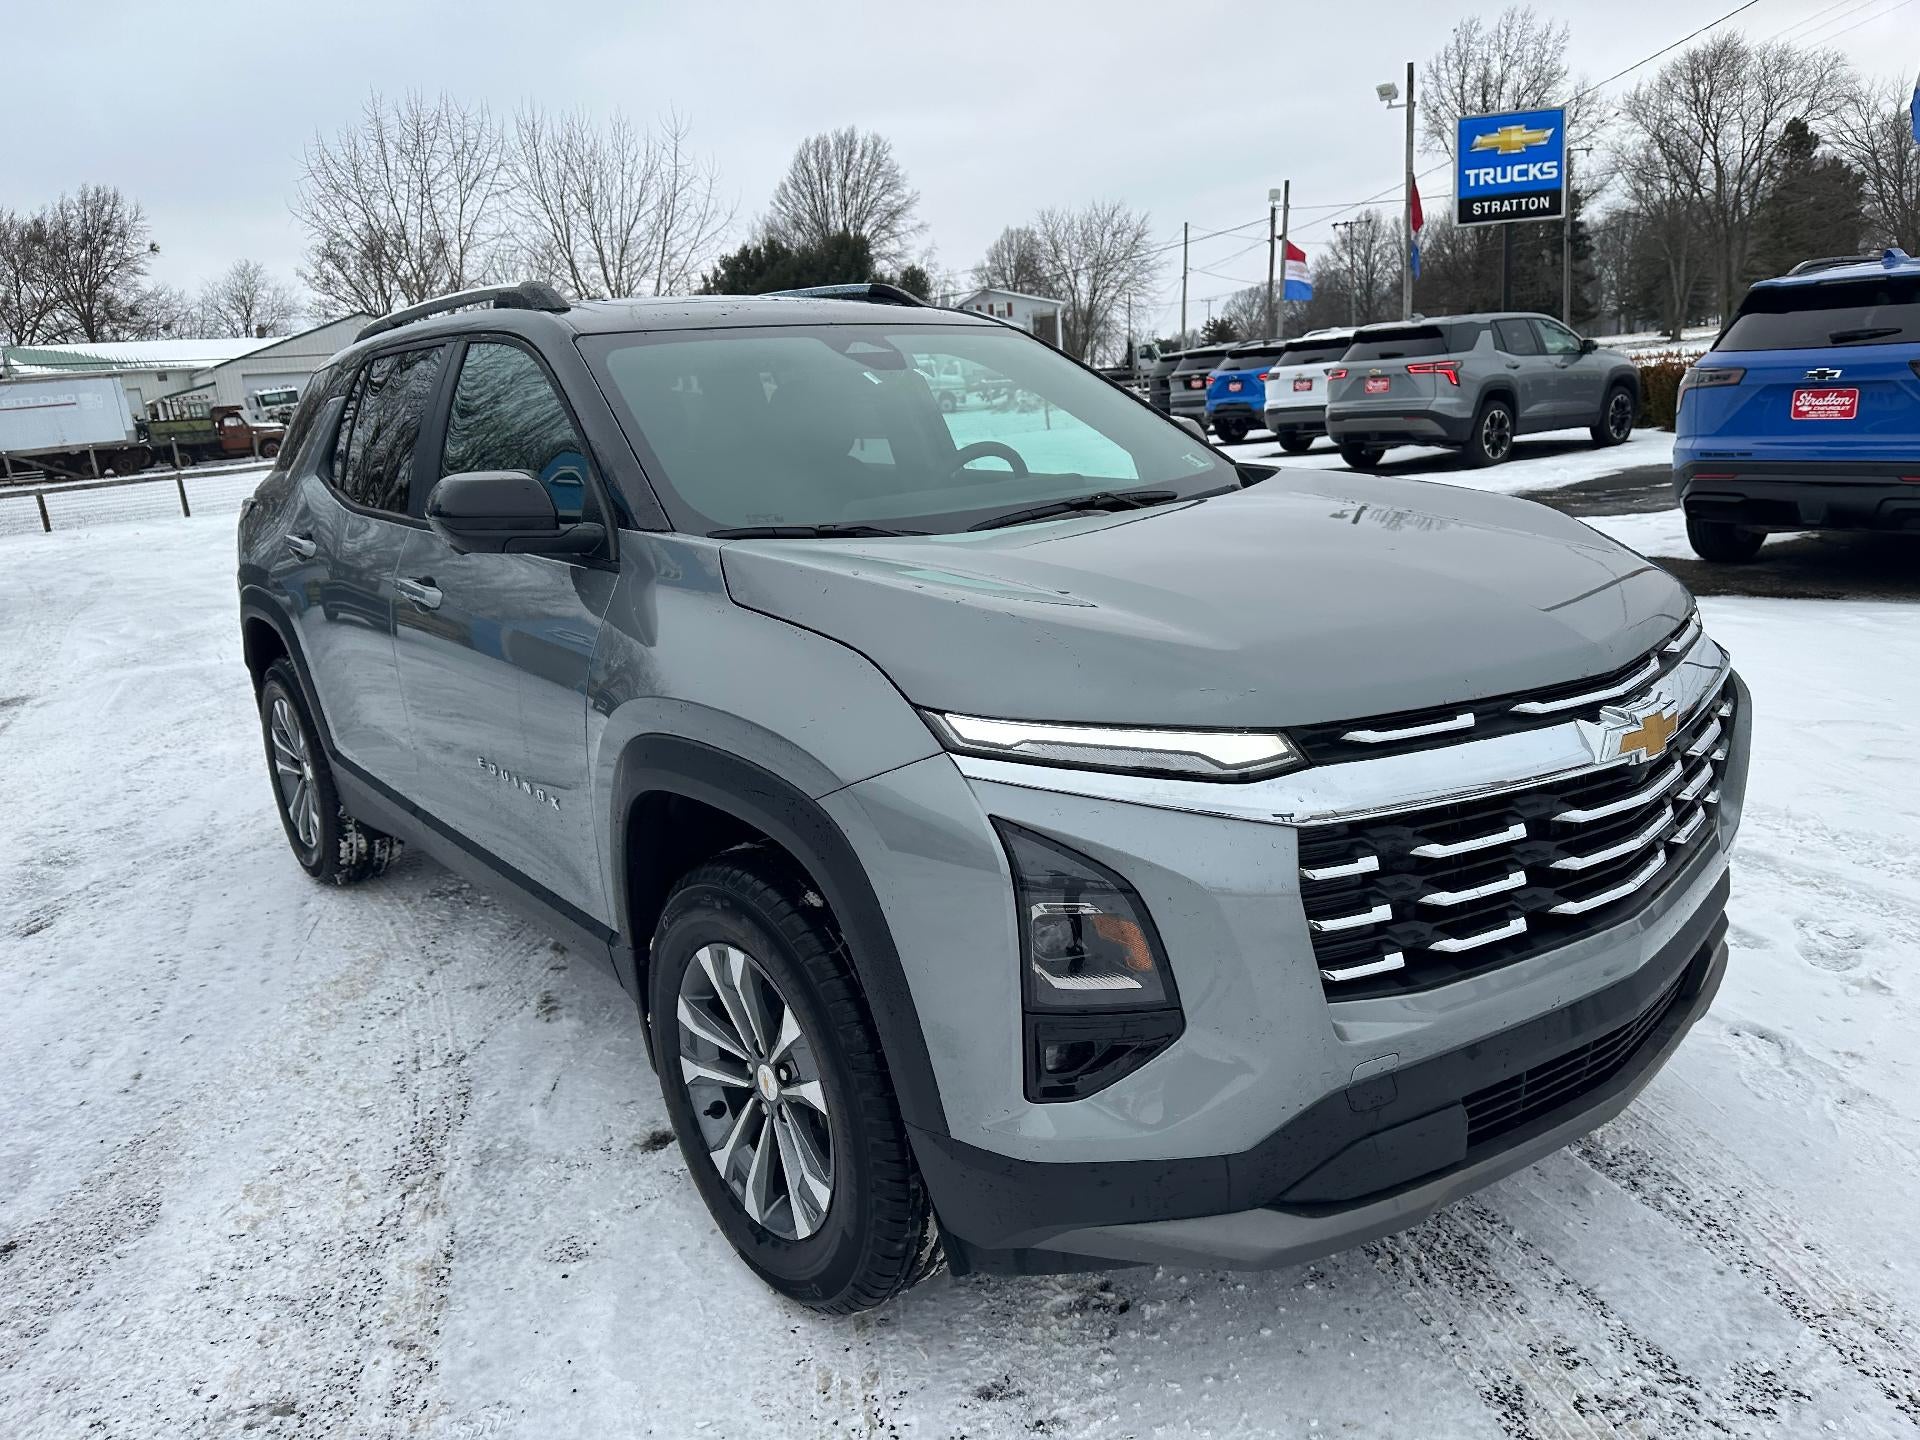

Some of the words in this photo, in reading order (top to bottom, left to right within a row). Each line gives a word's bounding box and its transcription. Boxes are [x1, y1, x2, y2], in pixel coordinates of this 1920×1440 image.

[1465, 161, 1558, 187] TRUCKS
[1472, 196, 1550, 215] STRATTON
[1795, 392, 1854, 406] Stratton
[477, 757, 561, 811] EQUINOX
